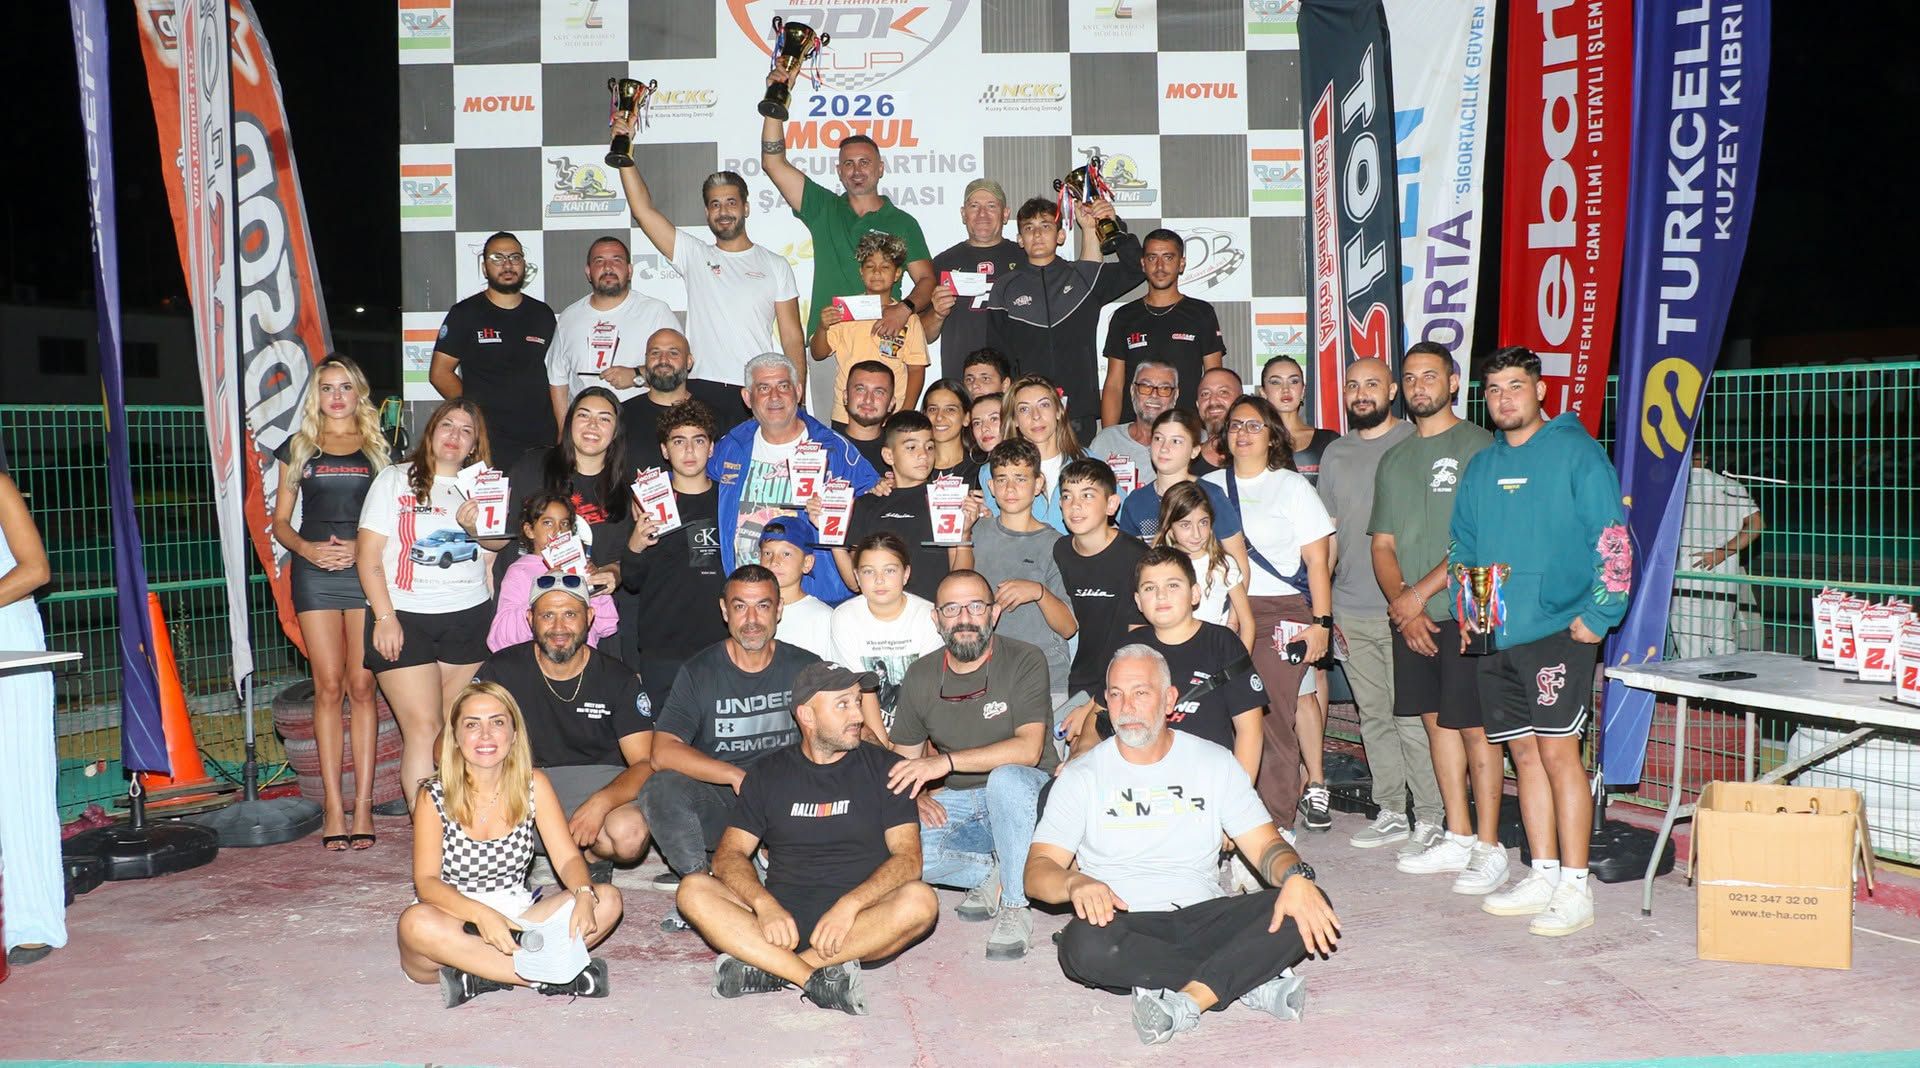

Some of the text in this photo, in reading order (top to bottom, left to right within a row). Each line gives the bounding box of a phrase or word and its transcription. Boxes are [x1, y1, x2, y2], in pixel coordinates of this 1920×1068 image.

[1466, 5, 1486, 68] GÜVEN
[1586, 0, 1606, 61] İŞLEM
[653, 90, 715, 105] NCKC
[1001, 83, 1062, 98] NCKC
[1165, 82, 1239, 99] MOTUL
[463, 96, 535, 113] MOTUL
[808, 94, 896, 118] 2026
[1588, 63, 1604, 143] DETAYLI
[1714, 1, 1743, 240] KUZEY KIBRI
[785, 119, 920, 150] MOTUL
[725, 158, 763, 178] RO
[884, 150, 977, 175] ARTİNG
[1657, 0, 1710, 345] TURKCELL
[1585, 165, 1603, 217] FİLMİ
[562, 201, 609, 212] KARTING
[1586, 222, 1601, 261] CAM
[477, 328, 502, 339] EHT
[1126, 333, 1148, 345] EHT
[1574, 281, 1598, 394] SİSTEMLERİ
[596, 350, 608, 369] 1.
[796, 477, 818, 498] 3.
[484, 506, 500, 530] 1.
[655, 502, 673, 525] 1.
[937, 514, 961, 534] 3.
[823, 516, 845, 536] 2.
[1864, 647, 1891, 670] 2.
[1728, 892, 1818, 906] 0212 347 32 00
[1730, 908, 1818, 921] www.te-ha.com
